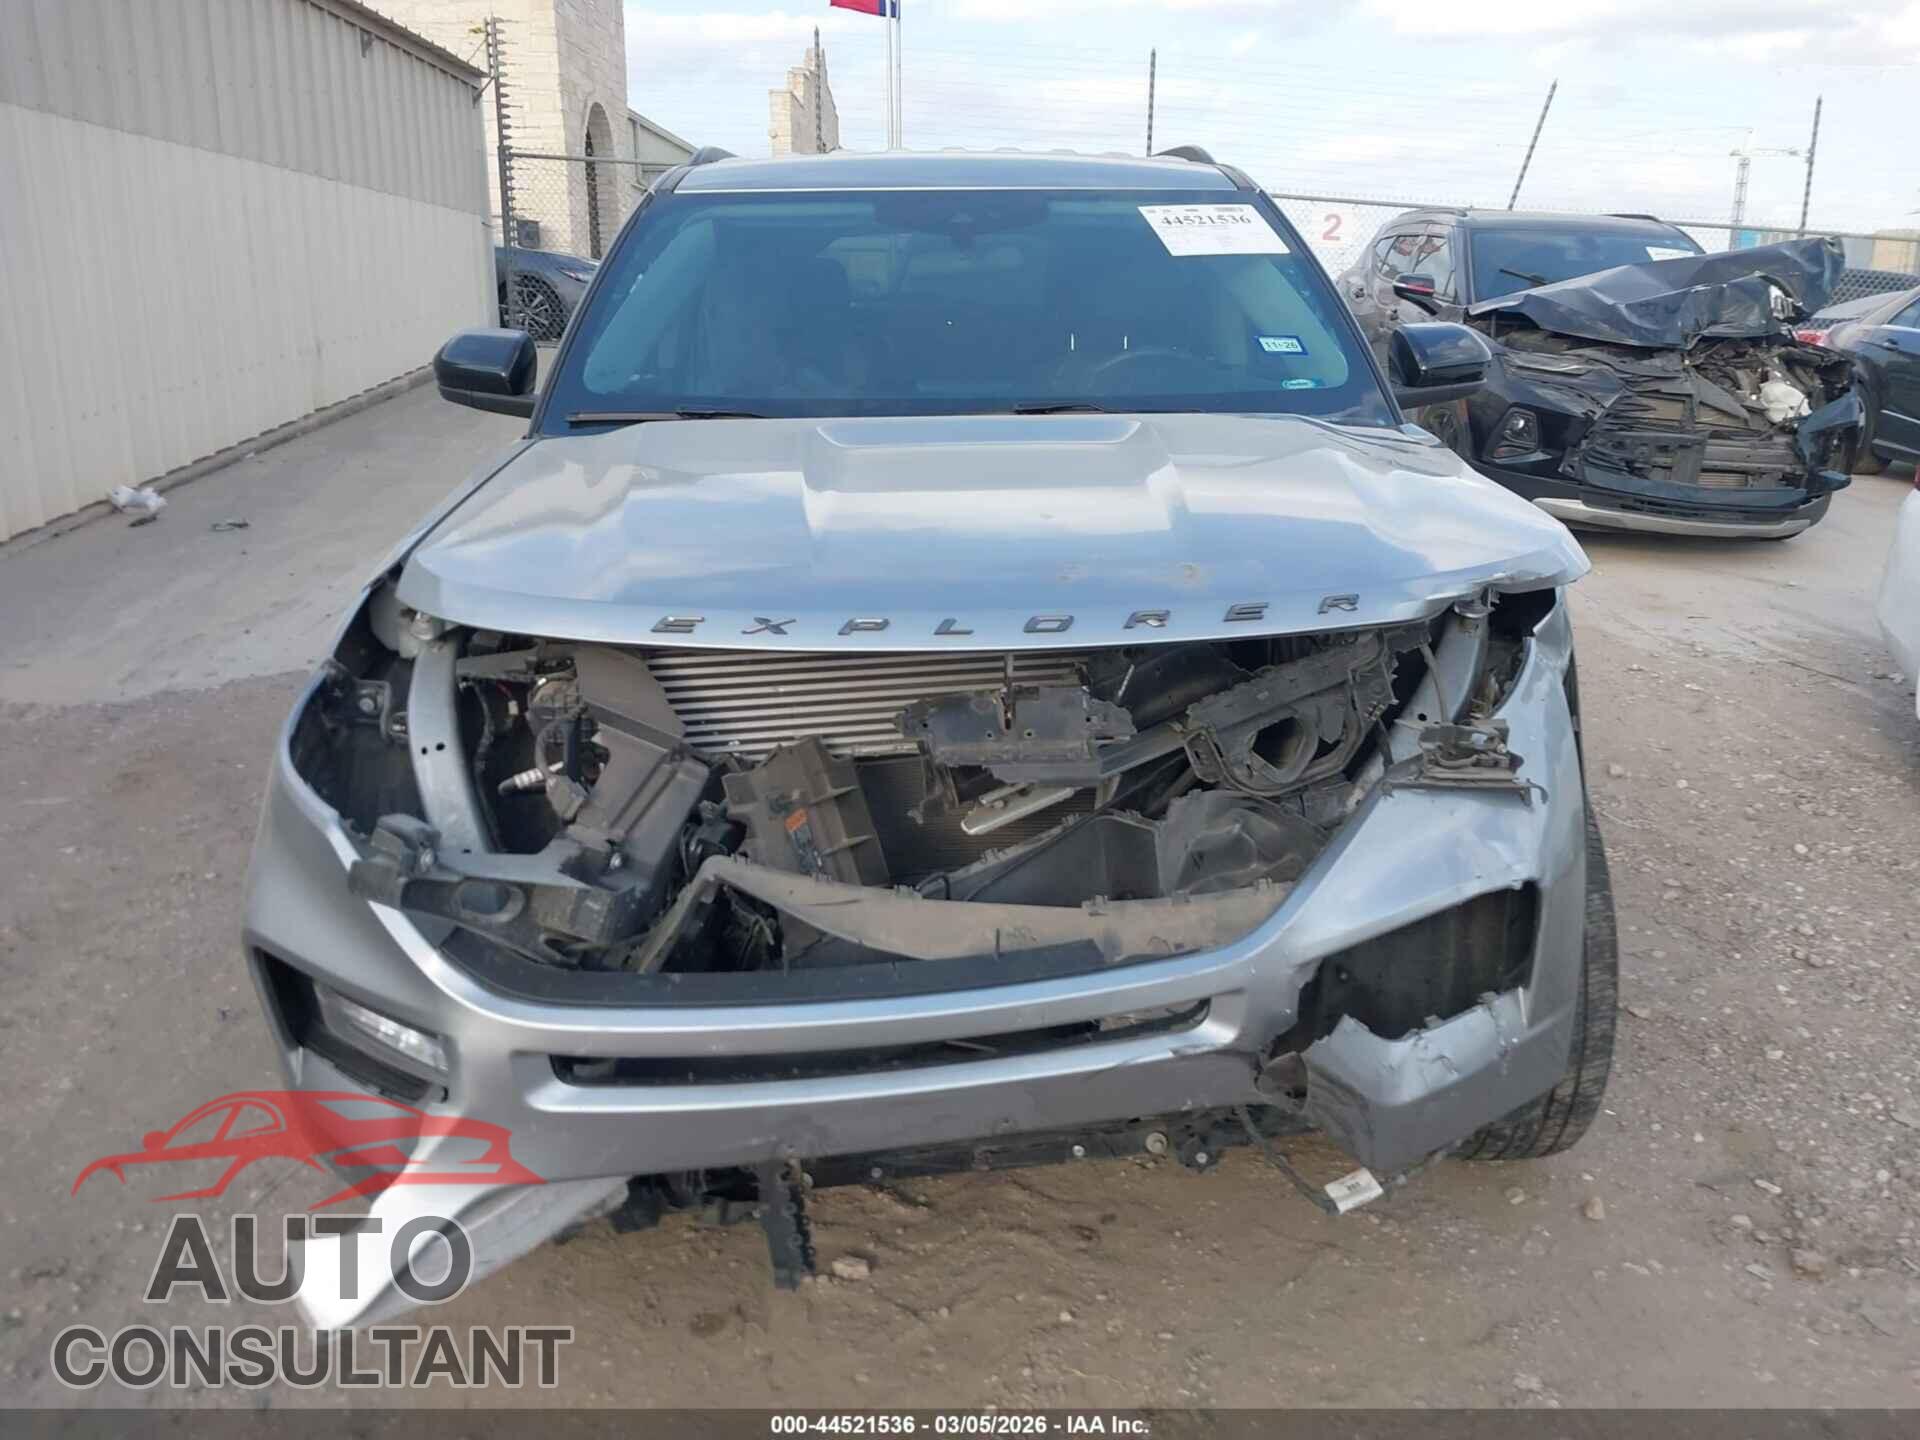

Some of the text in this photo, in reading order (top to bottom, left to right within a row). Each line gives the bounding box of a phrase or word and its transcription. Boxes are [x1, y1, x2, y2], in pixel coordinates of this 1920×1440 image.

[1161, 215, 1251, 226] 44521536
[1322, 213, 1343, 241] 2
[650, 593, 1360, 636] EXPLORER
